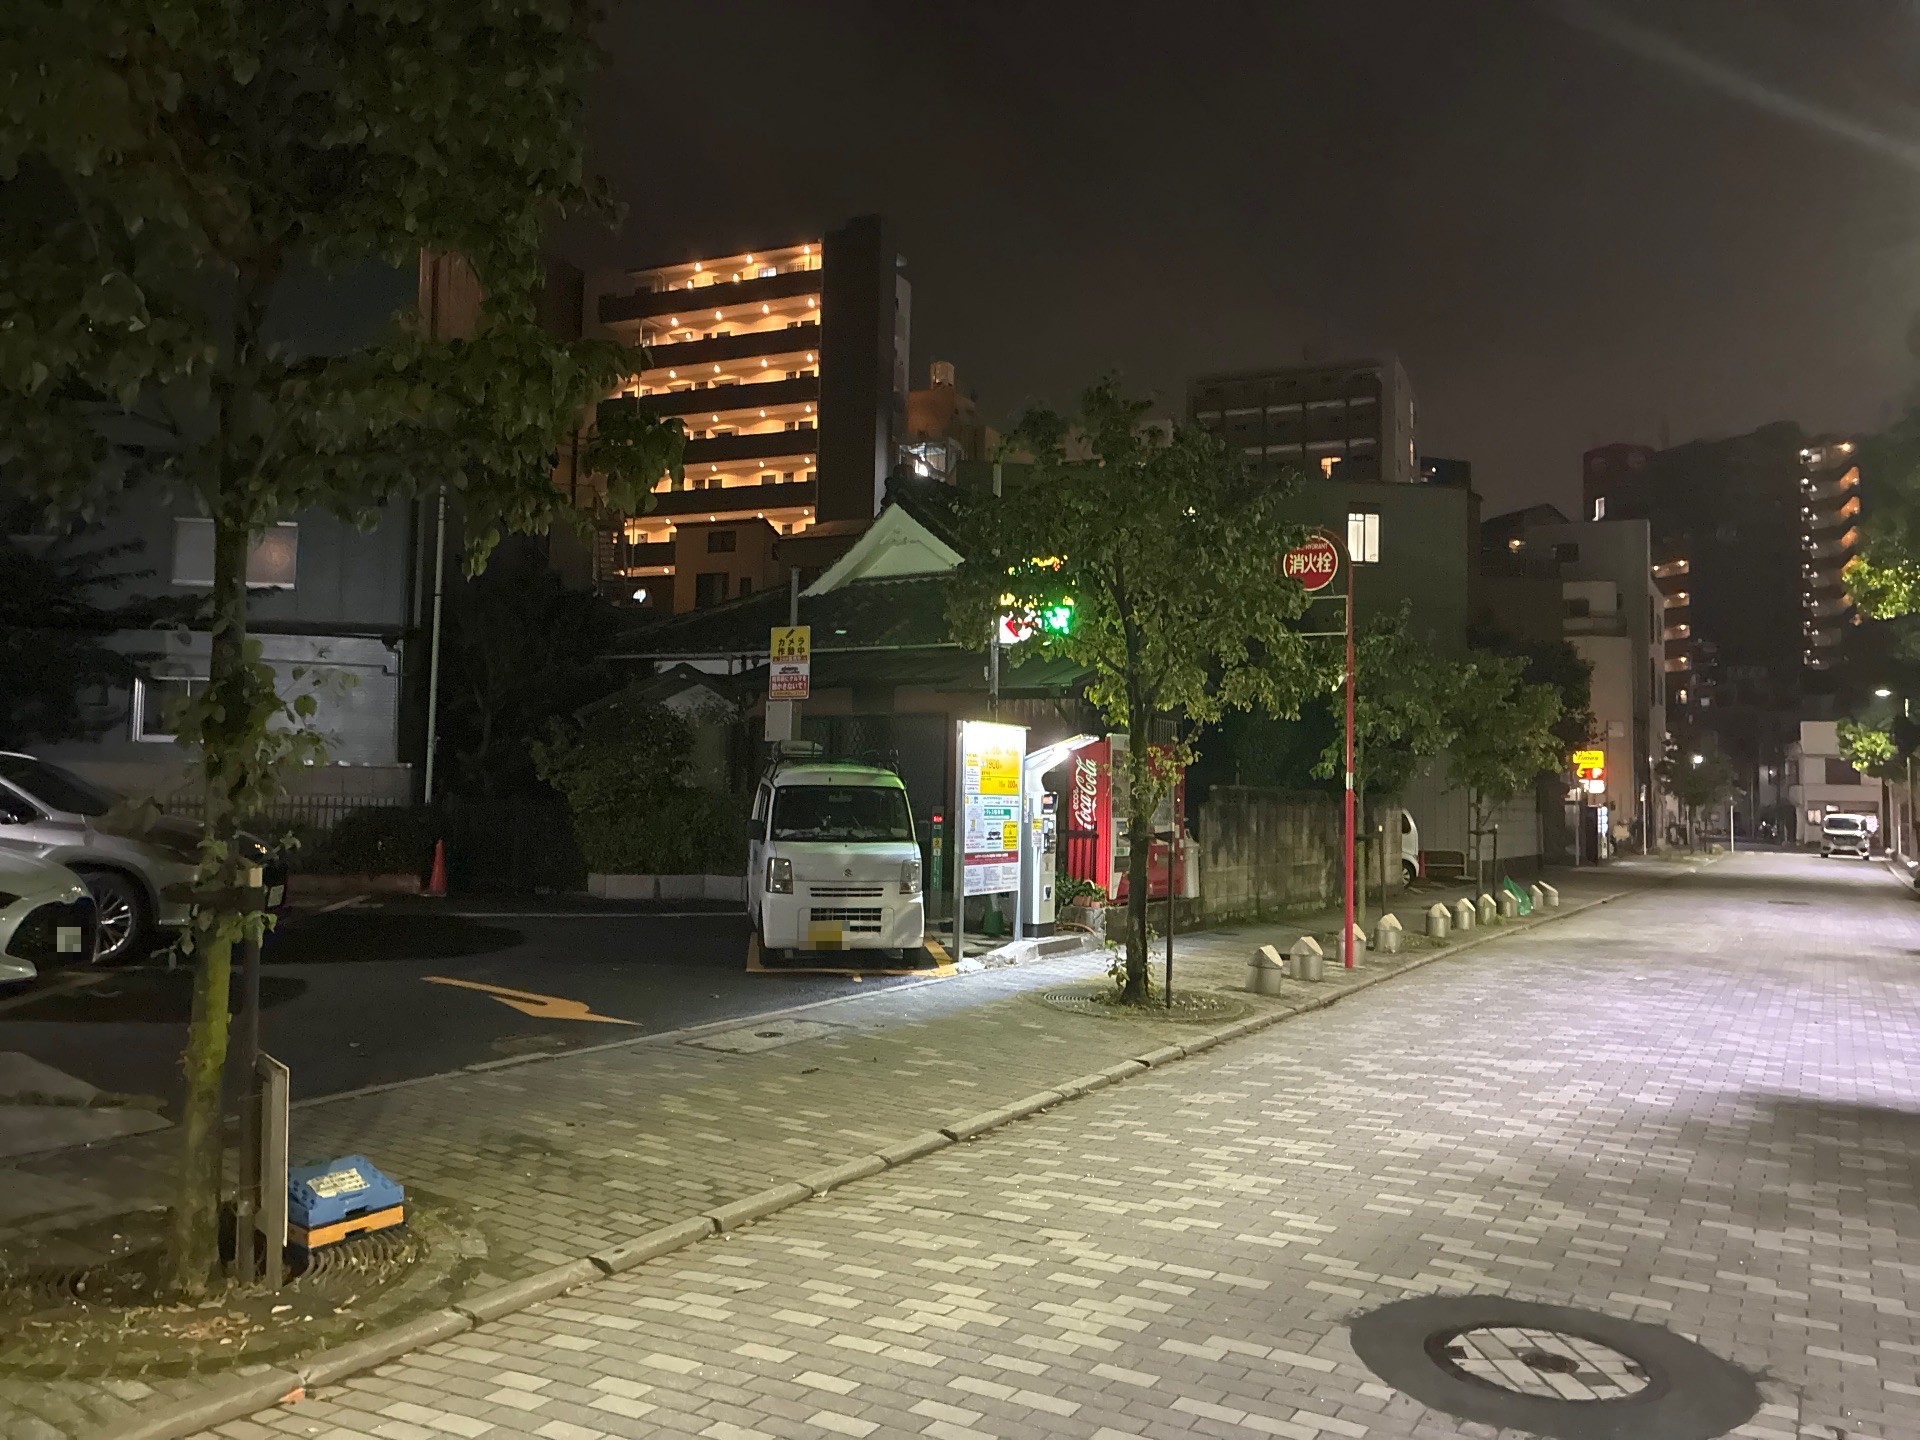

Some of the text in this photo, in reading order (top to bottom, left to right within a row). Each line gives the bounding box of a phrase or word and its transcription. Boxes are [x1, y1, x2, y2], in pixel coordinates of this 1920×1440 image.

[1289, 551, 1333, 574] 消火栓
[778, 637, 805, 647] カメラ
[778, 646, 805, 656] 作動中
